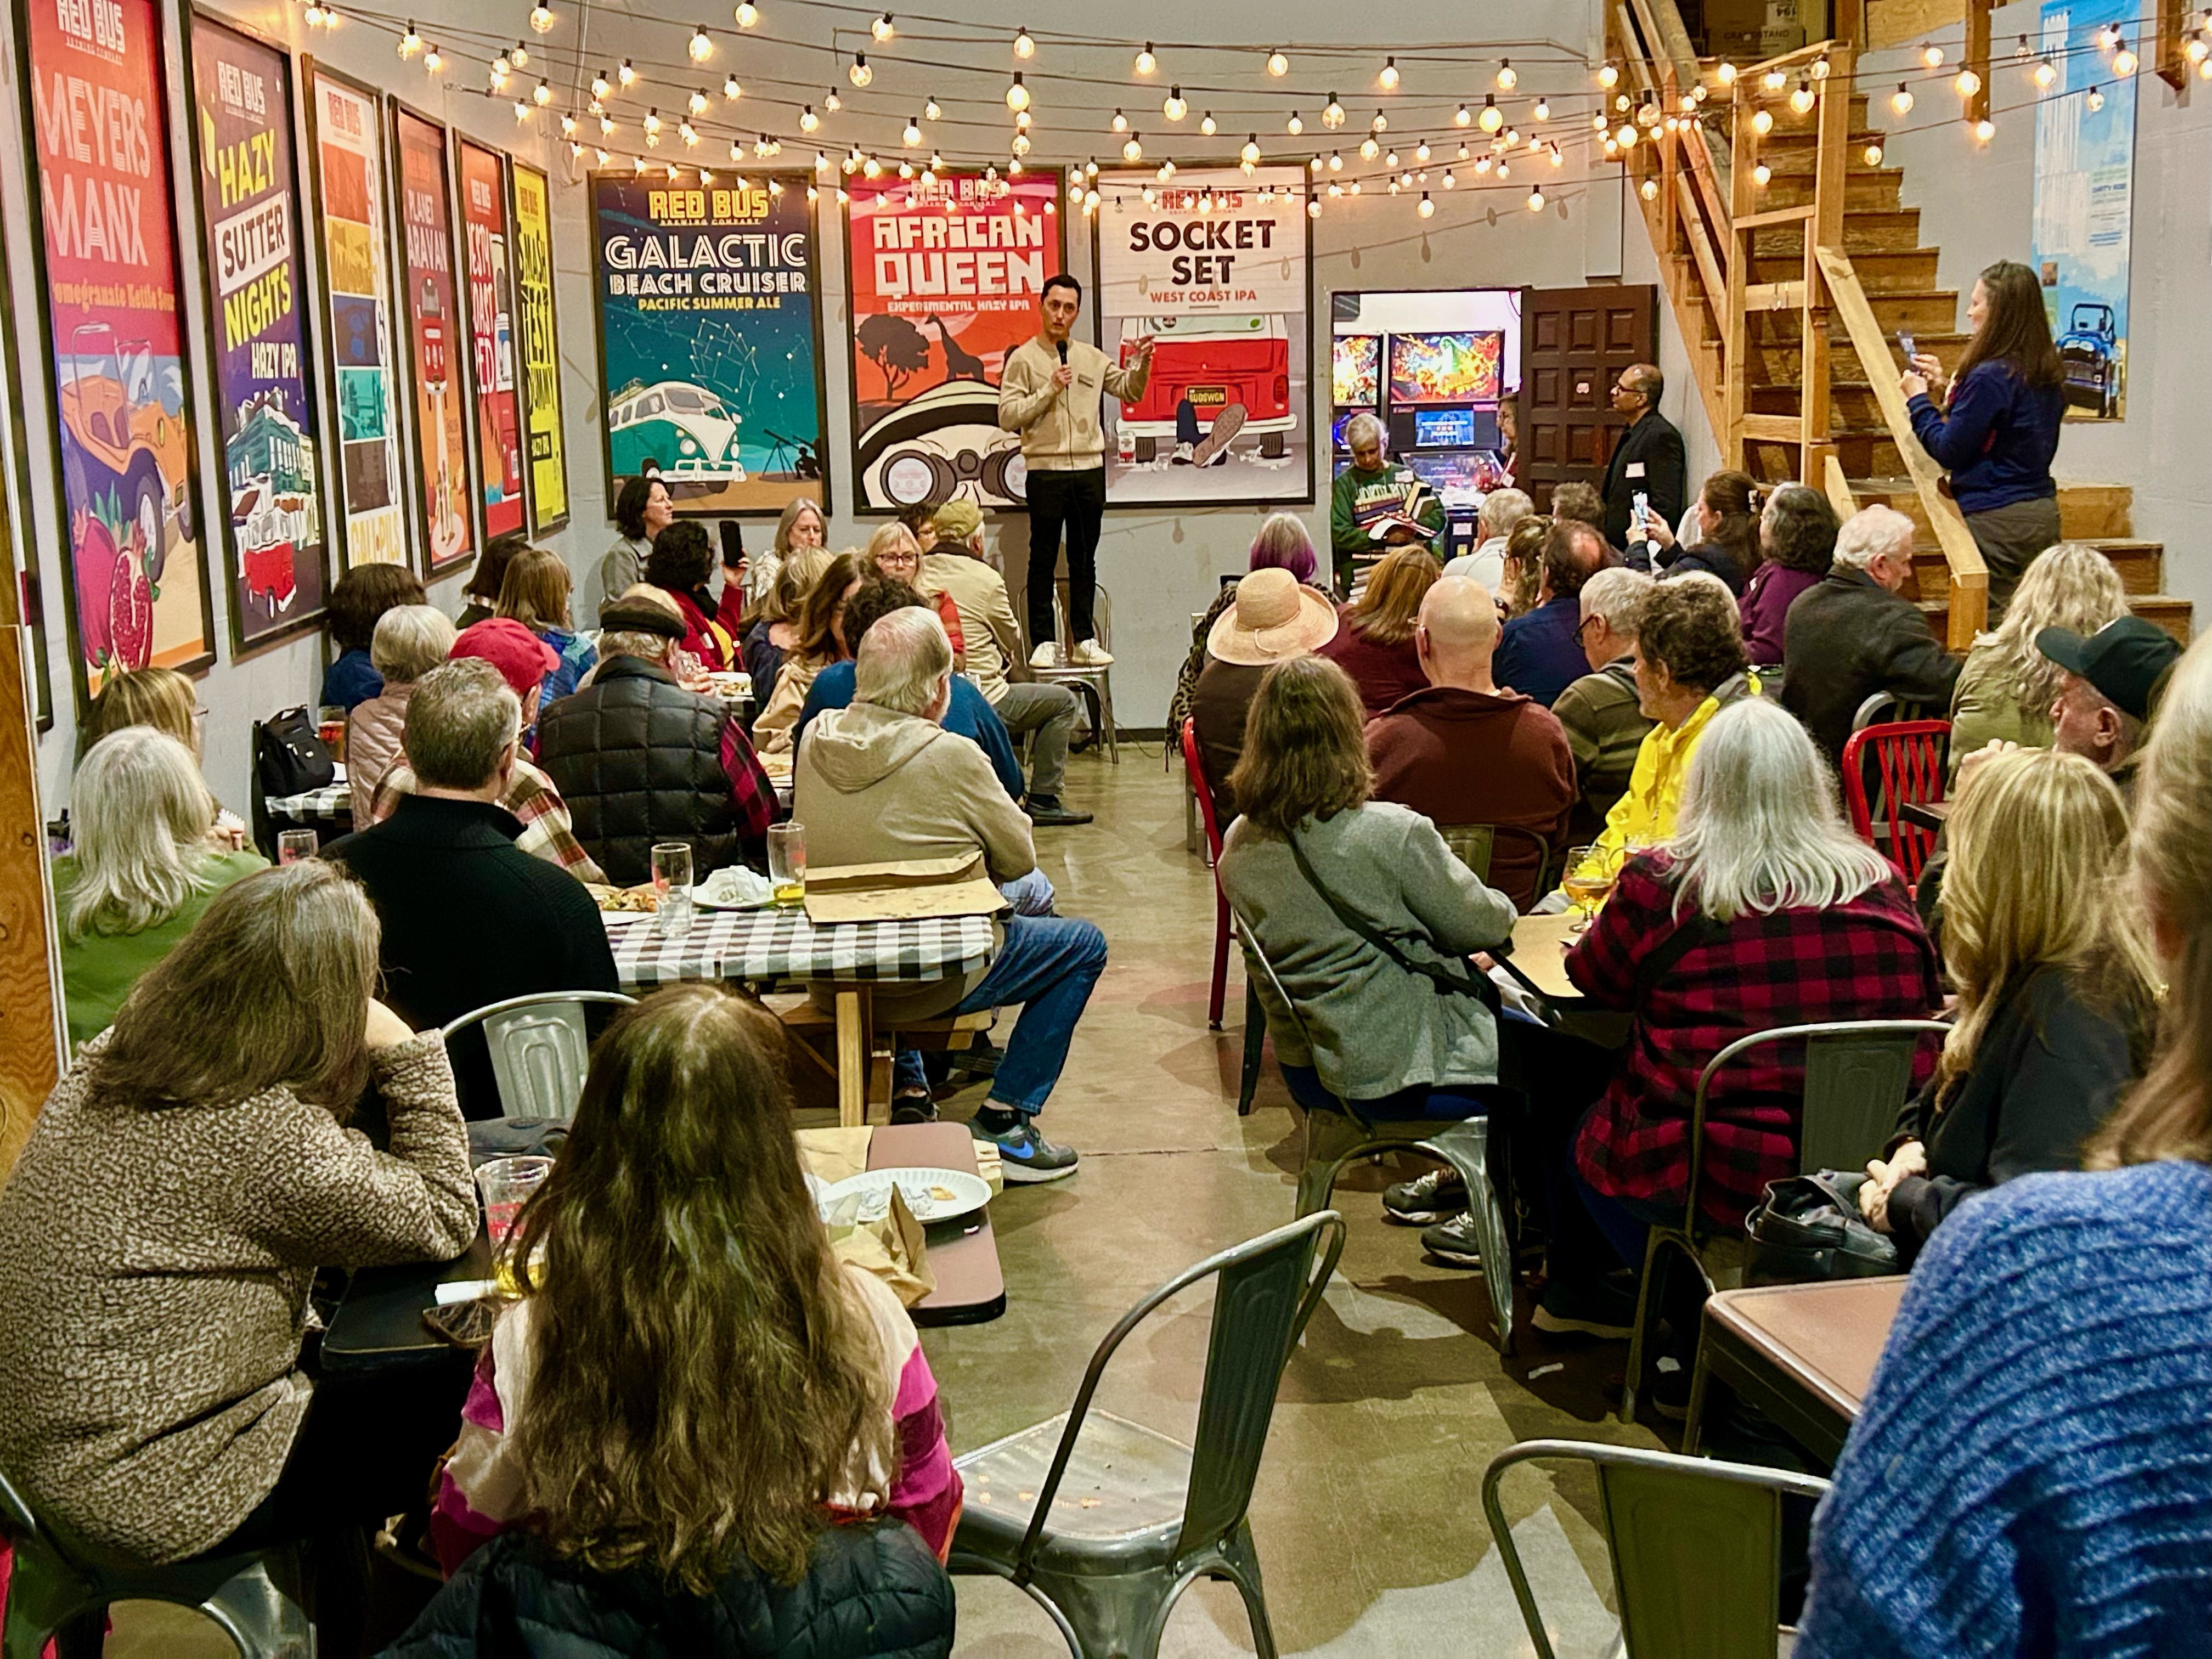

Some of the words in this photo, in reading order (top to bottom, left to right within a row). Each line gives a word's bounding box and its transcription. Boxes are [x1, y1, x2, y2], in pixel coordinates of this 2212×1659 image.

[92, 0, 125, 53] BUS
[217, 60, 242, 107] RED
[242, 69, 266, 115] BUS
[34, 66, 150, 178] MEYERS
[218, 129, 275, 208] HAZY
[42, 168, 149, 267] MANX
[648, 190, 704, 219] RED
[712, 189, 768, 218] BUS
[222, 201, 285, 279] SUTTER
[406, 223, 448, 273] ARAVAN
[605, 233, 806, 269] GALACTIC
[1130, 219, 1276, 252] SOCKET
[610, 273, 692, 295] BEACH
[700, 272, 805, 294] CRUISER
[874, 251, 1043, 300] QUEEN
[1171, 255, 1235, 285] SET
[52, 277, 127, 315] omegranate
[224, 262, 291, 352] NIGHTS
[638, 297, 690, 311] PACIFIC
[692, 297, 754, 310] SUMMER
[756, 296, 781, 309] ALE
[888, 301, 975, 313] EXPERIMENTAL
[977, 300, 1007, 311] HAZY
[1009, 300, 1030, 311] IPA
[1150, 292, 1184, 303] WEST
[1189, 291, 1230, 302] COAST
[1235, 290, 1256, 301] IPA
[251, 342, 279, 379] HAZY
[281, 342, 297, 378] IPA
